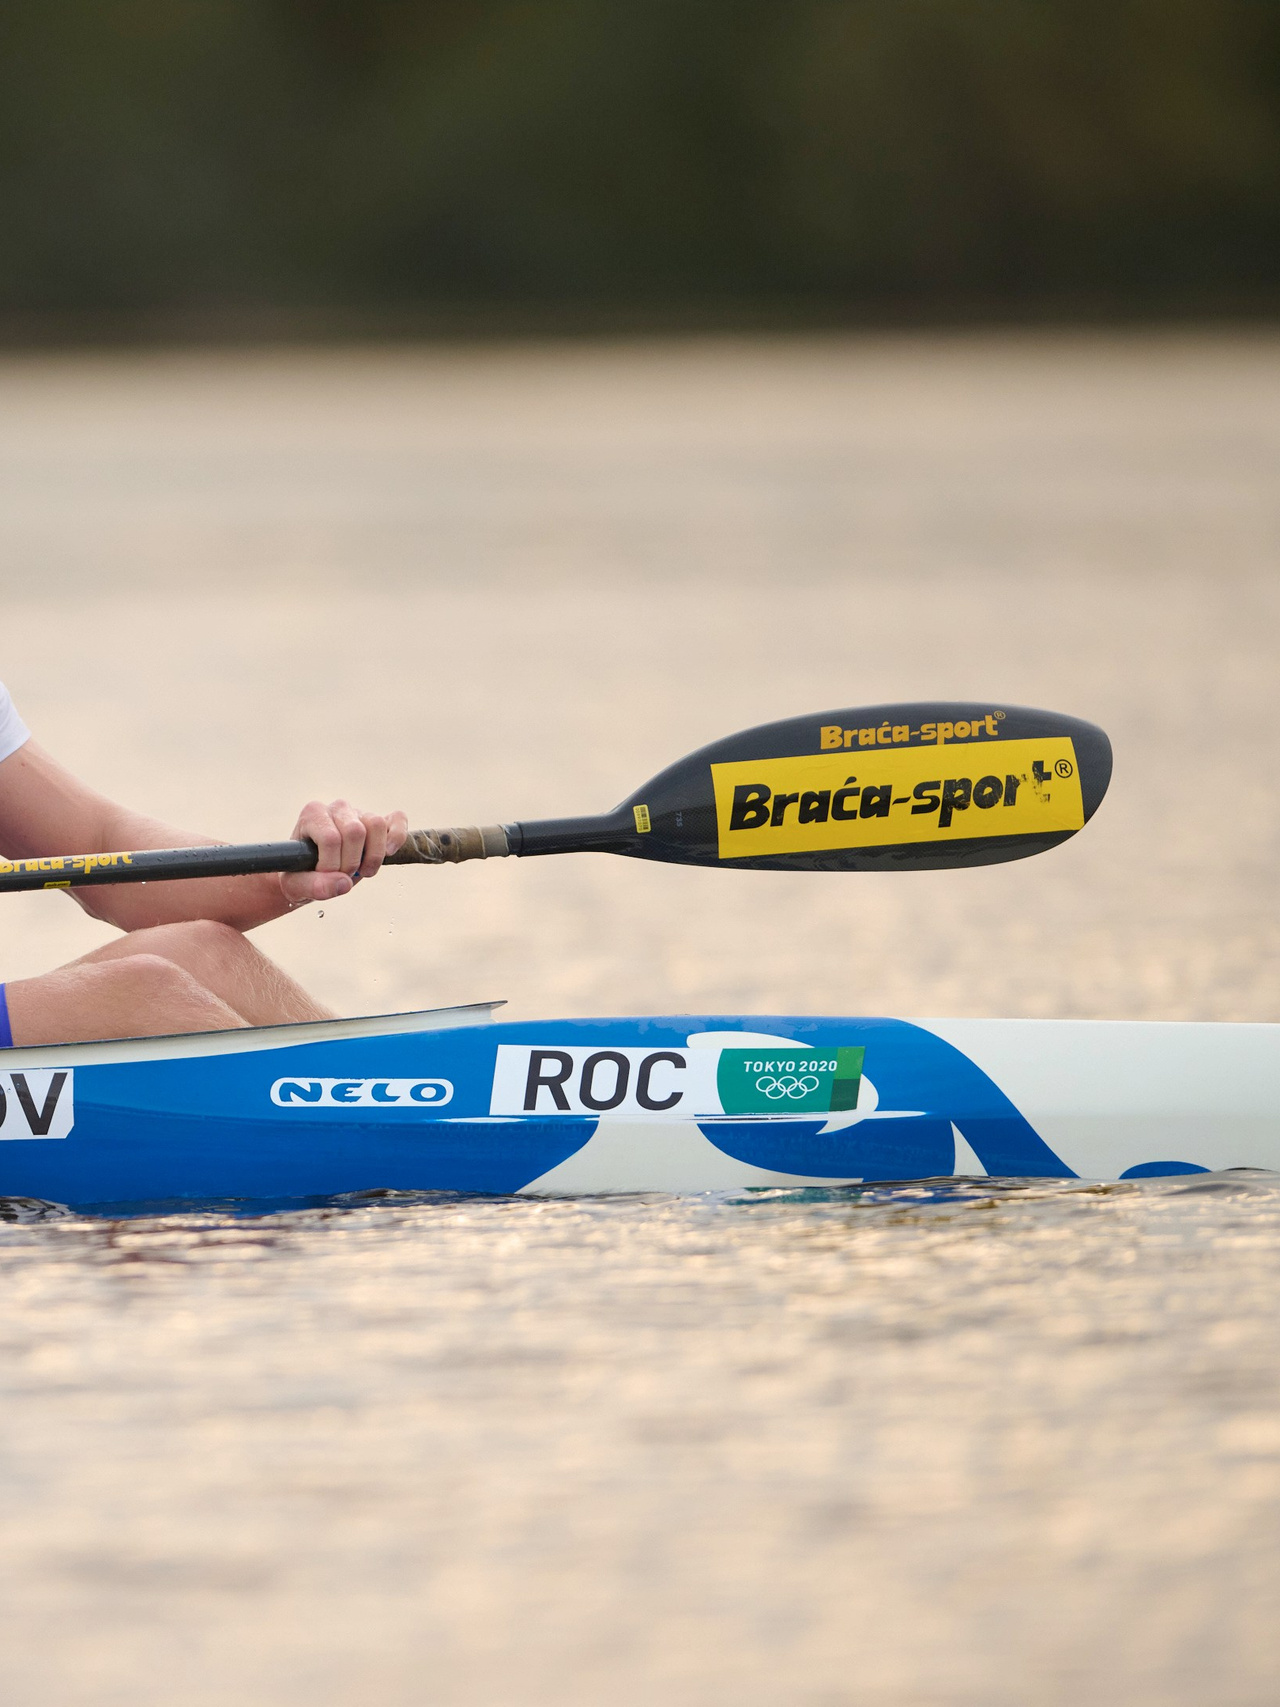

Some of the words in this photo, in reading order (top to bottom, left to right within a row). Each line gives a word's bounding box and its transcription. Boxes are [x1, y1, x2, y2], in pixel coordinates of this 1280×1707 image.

[744, 1060, 796, 1073] TOKYO
[799, 1060, 838, 1073] 2020
[523, 1050, 687, 1112] ROC
[279, 1082, 447, 1103] NELO
